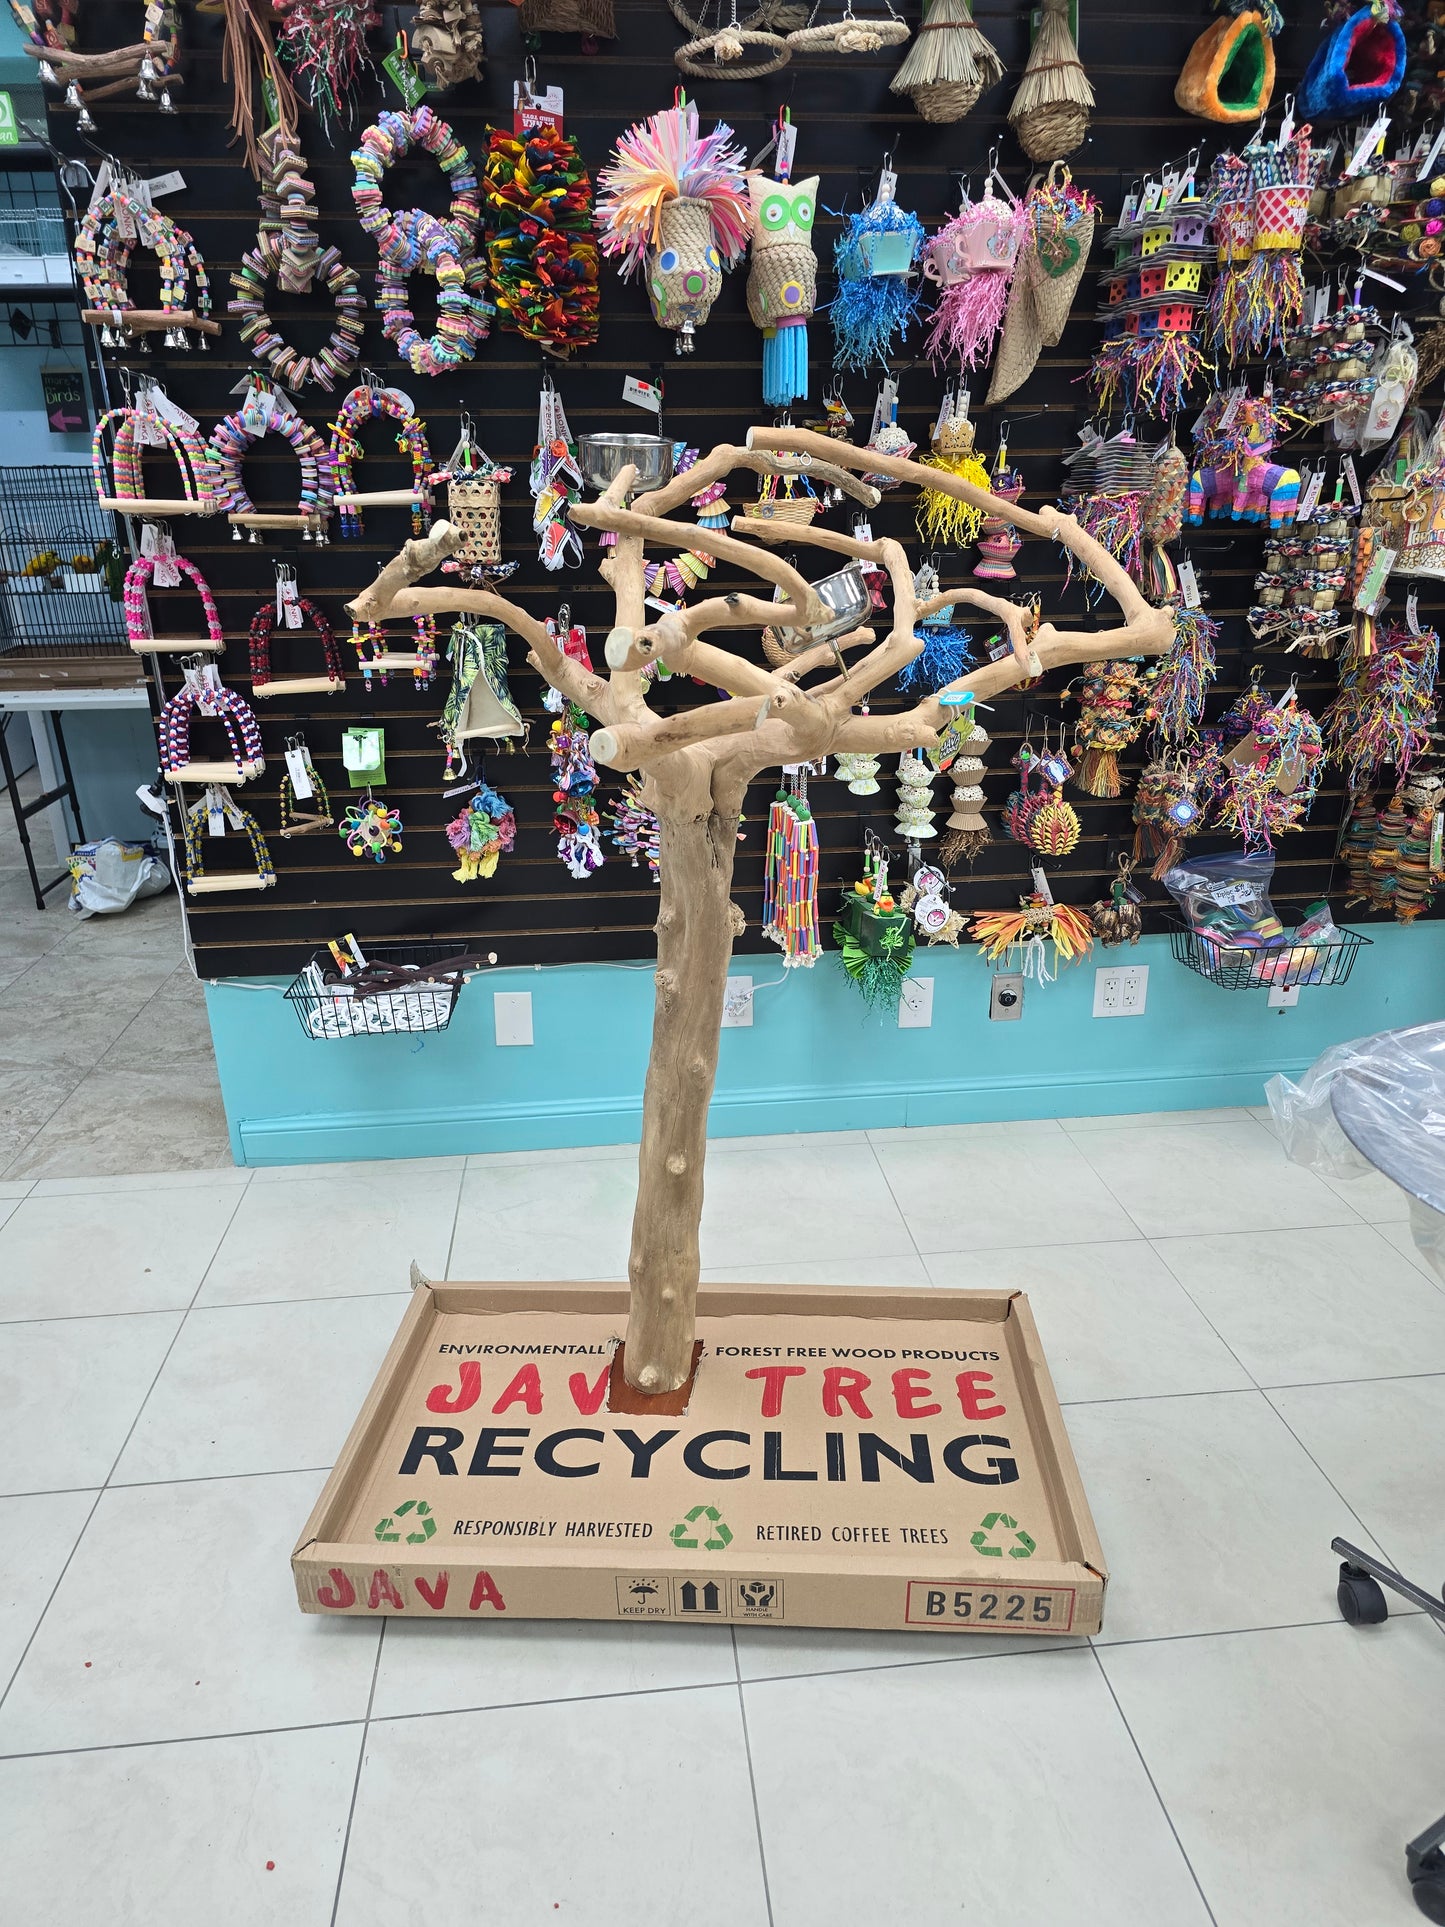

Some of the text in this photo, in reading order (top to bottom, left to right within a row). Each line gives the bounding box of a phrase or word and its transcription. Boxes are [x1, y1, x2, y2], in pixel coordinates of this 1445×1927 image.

[0, 131, 14, 142] an
[45, 386, 81, 405] Birds
[438, 1344, 606, 1355] ENVIRONMENTALL
[715, 1346, 783, 1357] FOREST
[787, 1347, 828, 1358] FREE
[832, 1347, 897, 1359] WOOD
[901, 1349, 1000, 1361] PRODUCTS
[425, 1360, 1007, 1421] JAV TREE
[397, 1426, 1021, 1486] RECYCLING
[453, 1519, 654, 1539] RESPONSIBLY HARVESTED
[756, 1525, 949, 1545] RETIRED COFFEE TREES
[317, 1567, 507, 1611] JAVA
[622, 1606, 667, 1615] KEEP DRY
[925, 1590, 1053, 1623] B5225
